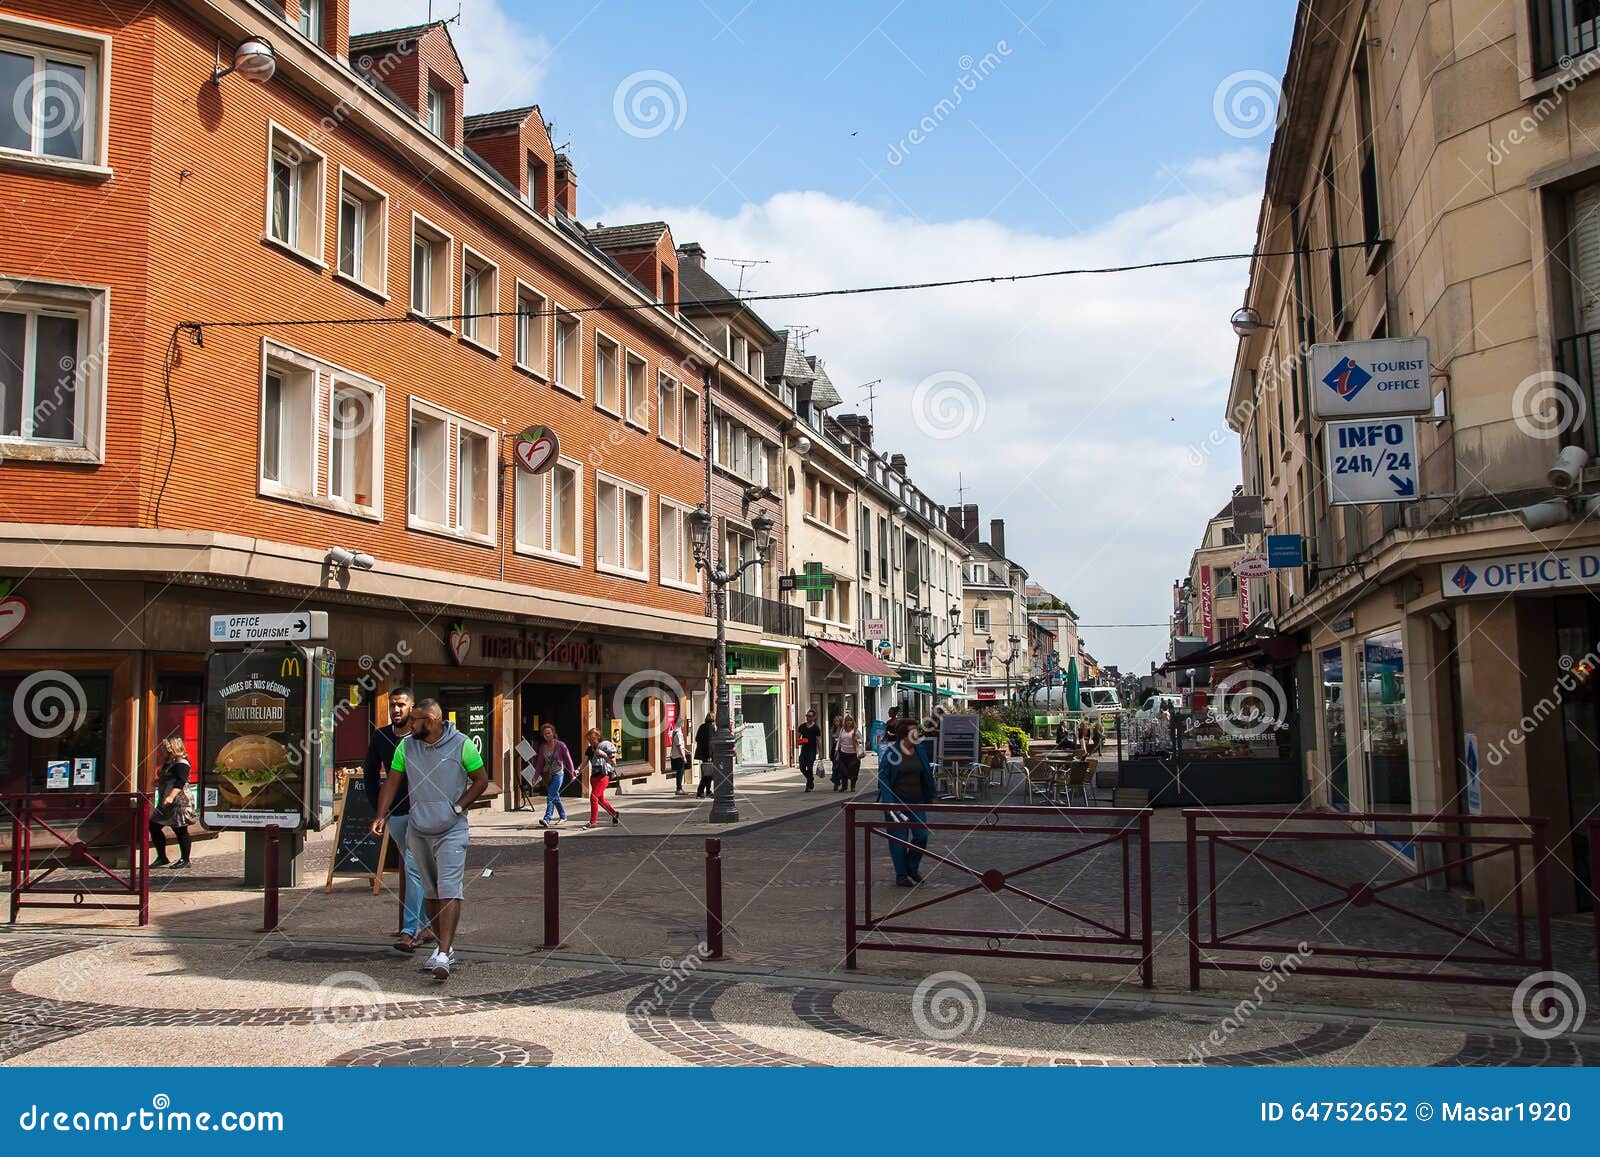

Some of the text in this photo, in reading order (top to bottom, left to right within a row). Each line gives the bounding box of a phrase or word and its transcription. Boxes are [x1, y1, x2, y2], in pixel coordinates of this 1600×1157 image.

[1371, 359, 1424, 373] TOURIST
[1377, 380, 1421, 391] OFFICE
[1338, 423, 1404, 449] INFO
[1335, 449, 1412, 477] 24h/24
[1484, 557, 1572, 587] OFFICE
[229, 616, 260, 627] OFFICE
[230, 627, 290, 639] DE TOURISME
[219, 680, 291, 698] VIANDES DE NOS RÉGIONS
[1226, 732, 1276, 741] BRASSERIE
